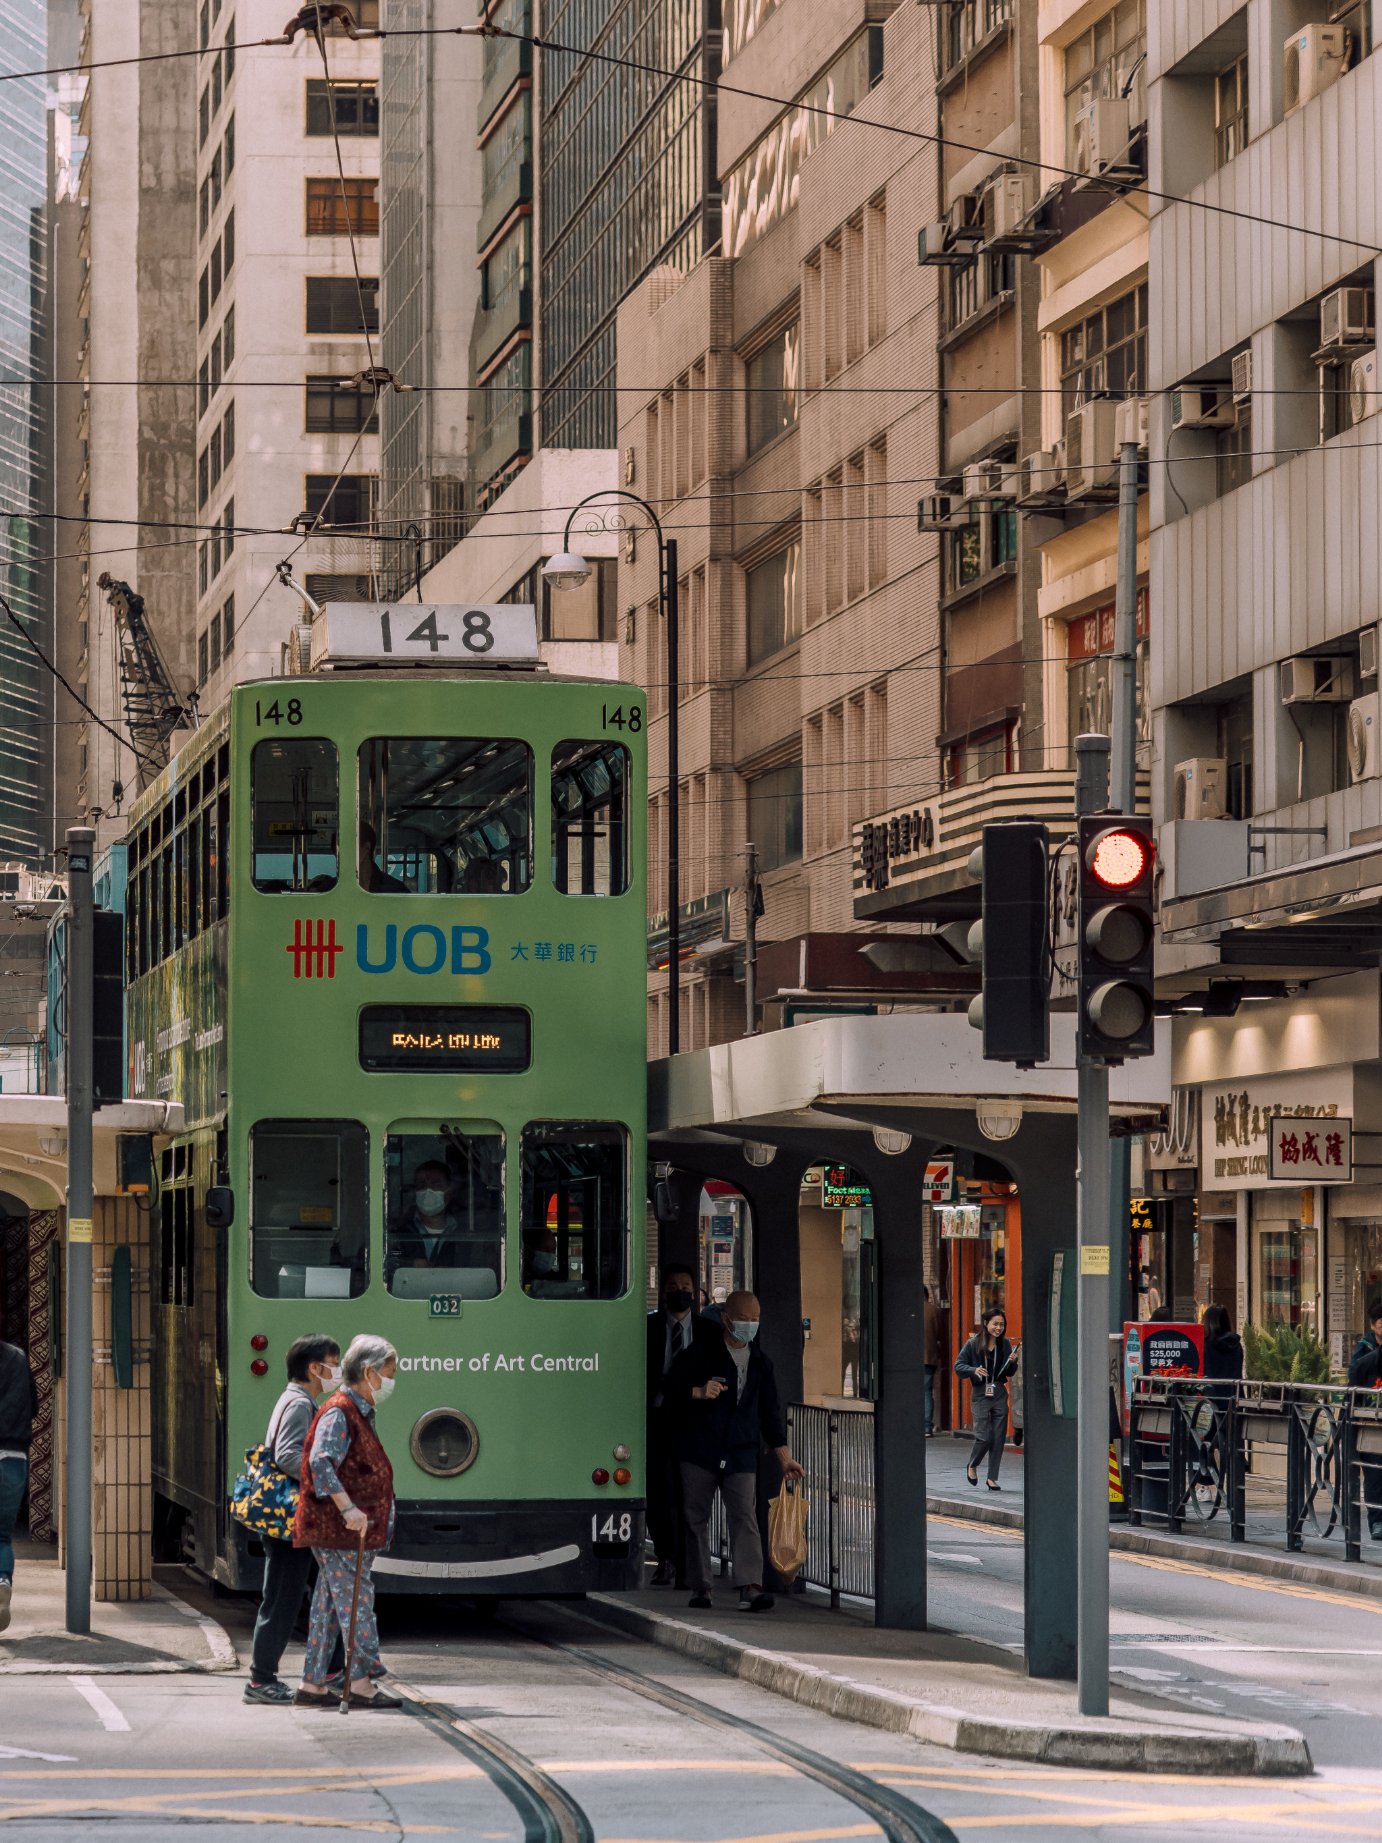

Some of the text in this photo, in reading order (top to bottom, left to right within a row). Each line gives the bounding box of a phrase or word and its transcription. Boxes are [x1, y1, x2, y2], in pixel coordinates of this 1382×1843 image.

[380, 610, 495, 653] 148
[255, 698, 303, 726] 148
[602, 703, 642, 733] 148
[356, 924, 492, 975] UOB
[510, 941, 598, 963] 大華銀行
[1279, 1131, 1345, 1166] 協成隆
[830, 1169, 845, 1186] 好
[433, 1300, 459, 1313] 032
[395, 1353, 599, 1371] artner of Art Central
[1149, 1350, 1181, 1358] $25,000
[592, 1513, 632, 1542] 148
